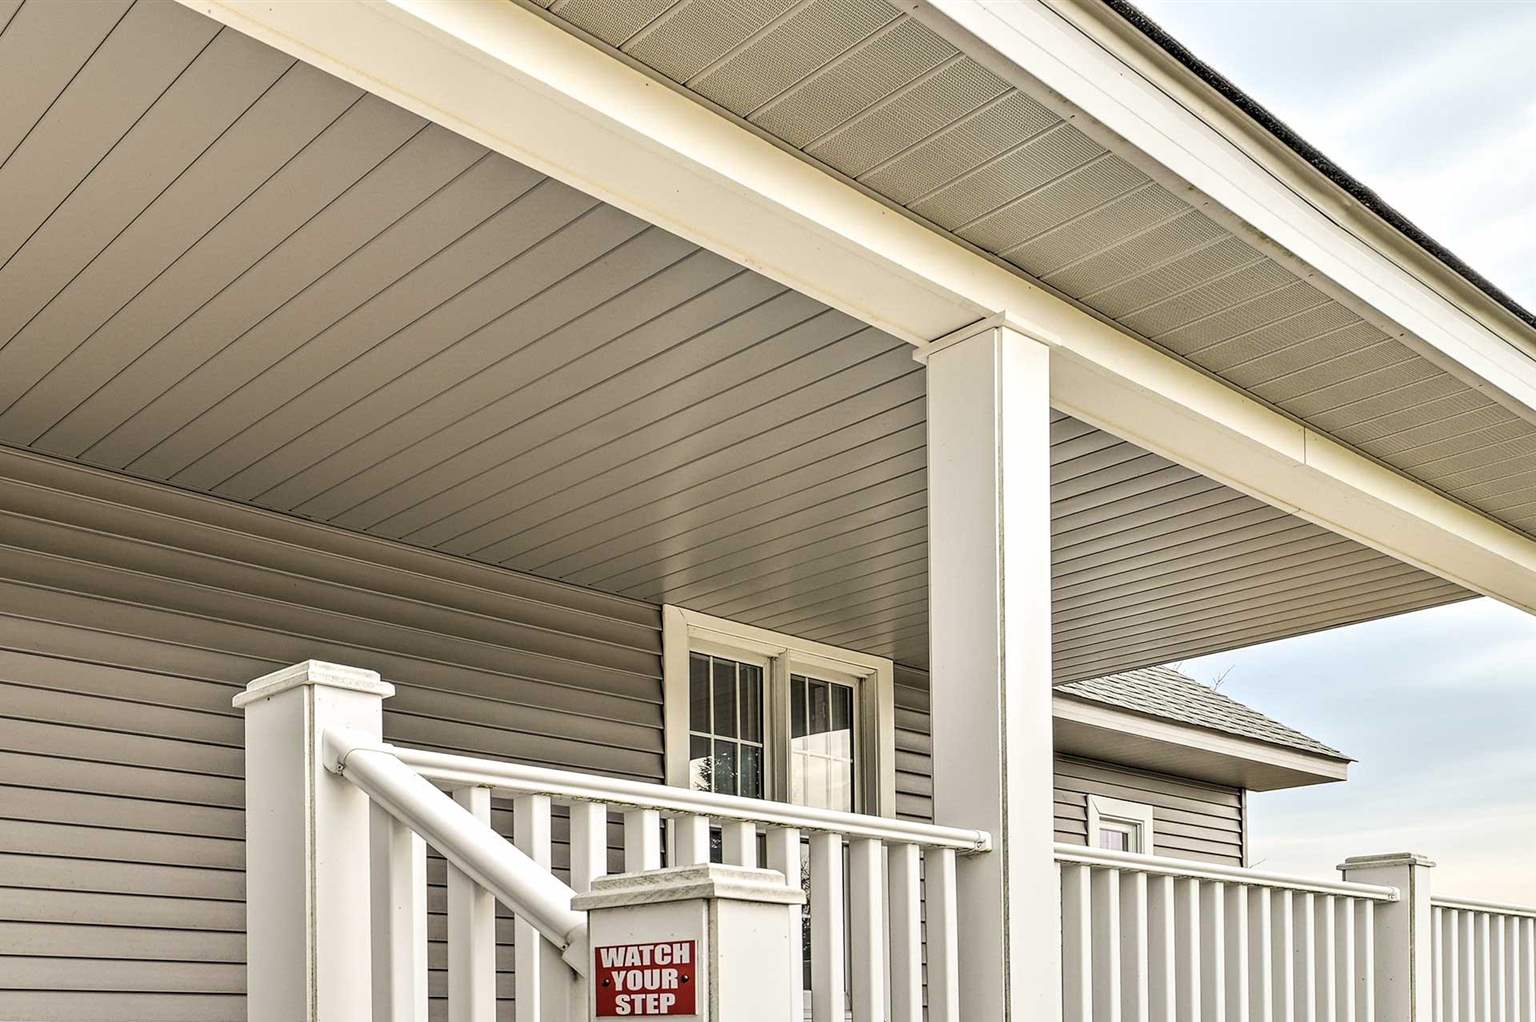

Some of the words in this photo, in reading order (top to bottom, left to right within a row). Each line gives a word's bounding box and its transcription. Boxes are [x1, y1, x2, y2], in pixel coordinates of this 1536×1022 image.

[600, 943, 690, 968] WATCH
[611, 968, 678, 991] YOUR
[615, 993, 676, 1015] STEP
